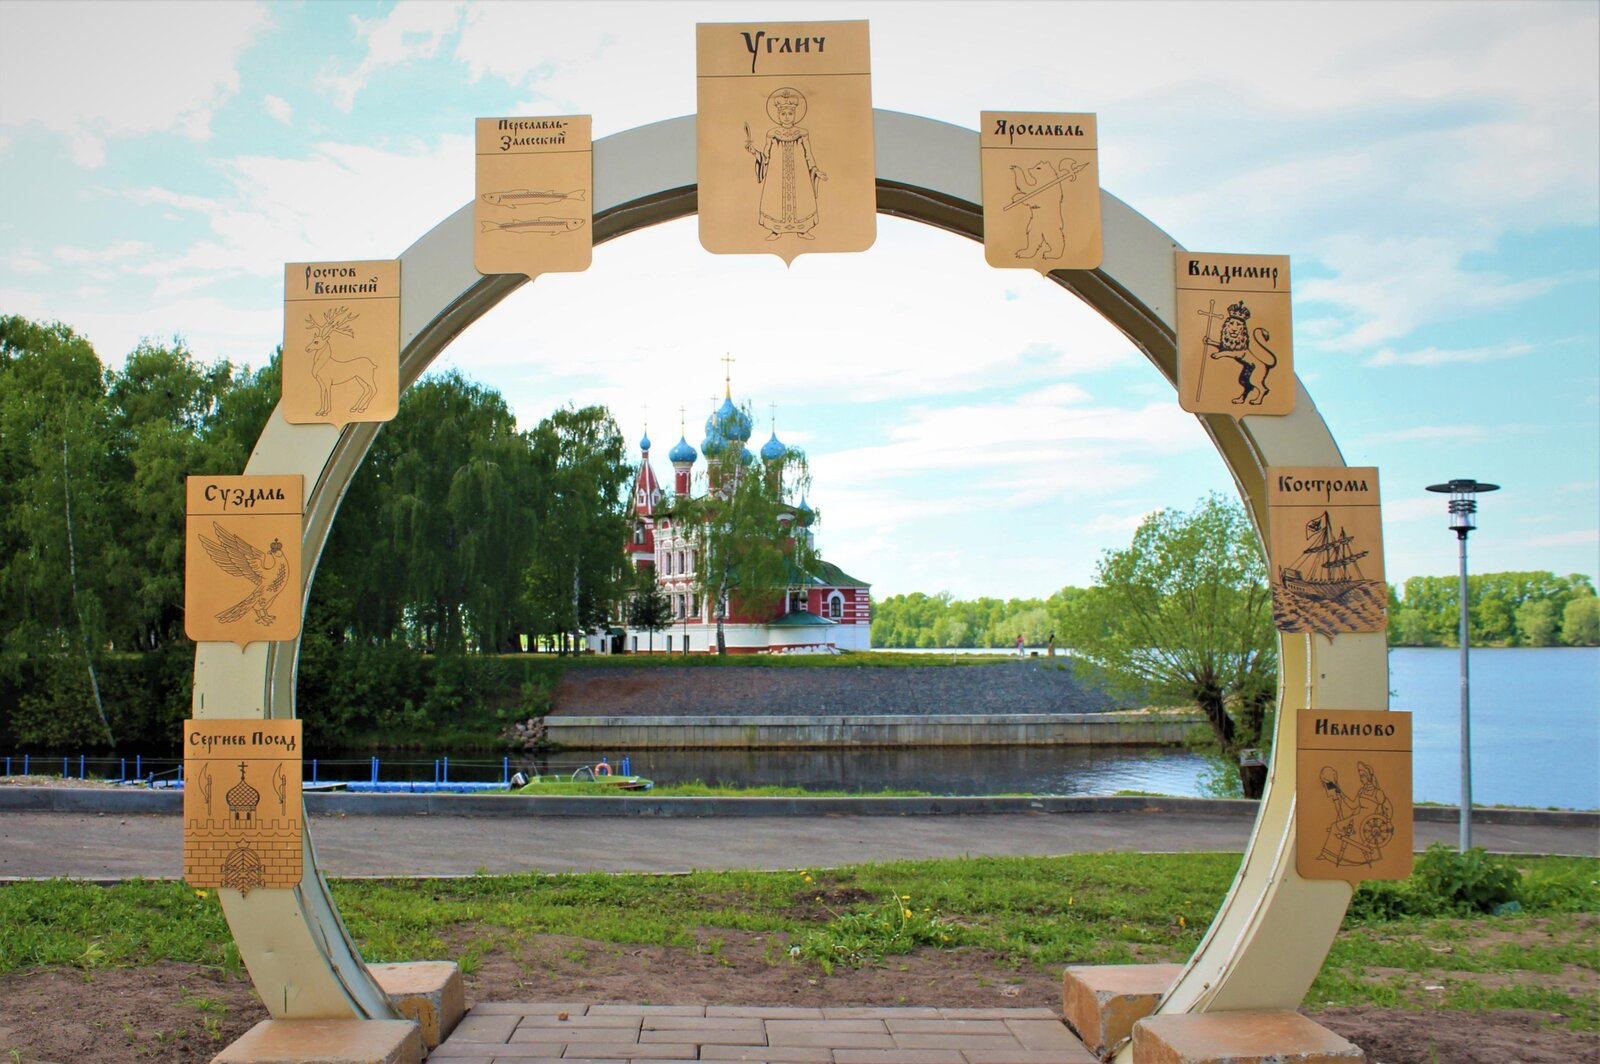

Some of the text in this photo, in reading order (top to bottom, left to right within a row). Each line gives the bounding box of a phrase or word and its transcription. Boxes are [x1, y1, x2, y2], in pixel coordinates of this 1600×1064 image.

[739, 30, 826, 74] Углич
[498, 119, 568, 137] Переславль-
[993, 119, 1084, 145] Ярославль
[499, 132, 565, 152] Залесский
[314, 278, 379, 295] Великий
[1188, 260, 1278, 289] Владимир
[204, 484, 285, 511] Суздаль
[1278, 475, 1369, 503] Кострома
[1315, 718, 1395, 737] Иваново
[189, 731, 296, 754] Сергиев Посад
